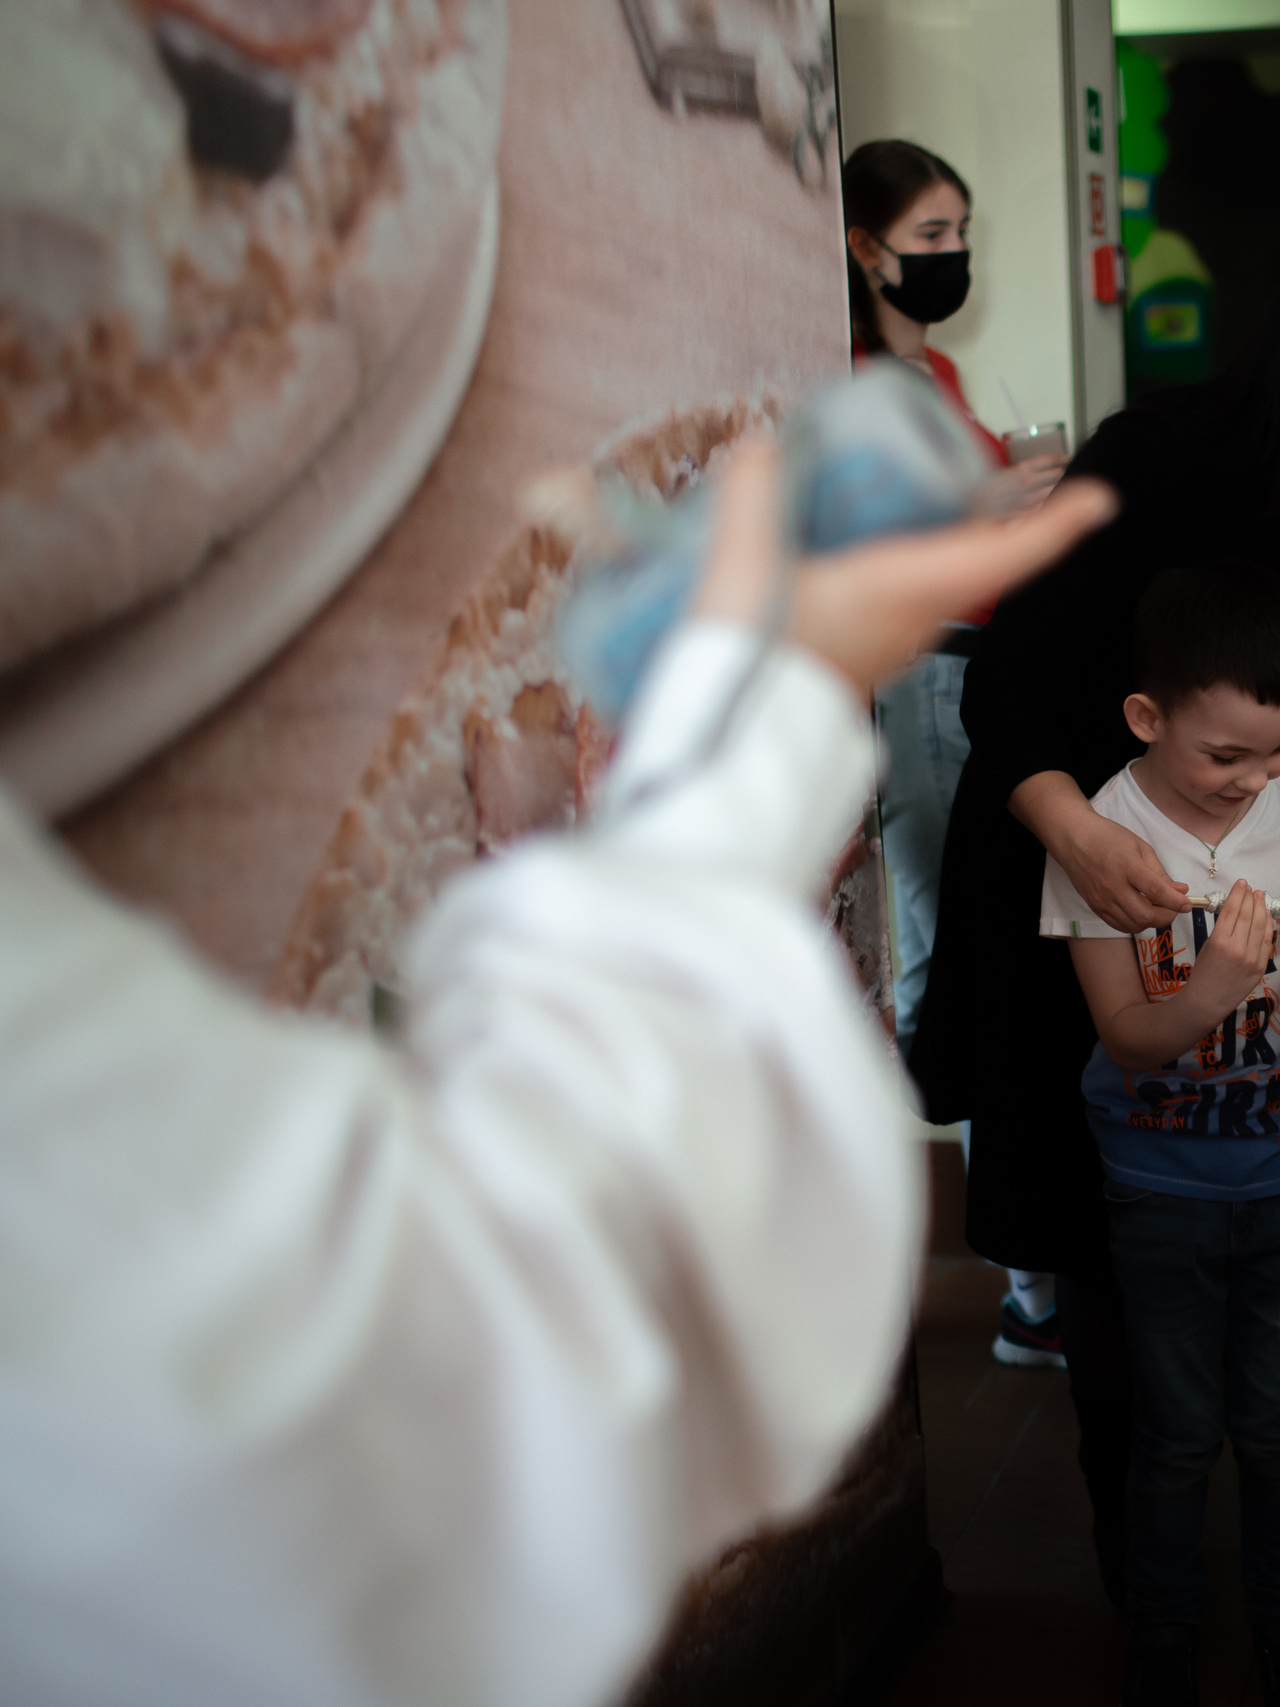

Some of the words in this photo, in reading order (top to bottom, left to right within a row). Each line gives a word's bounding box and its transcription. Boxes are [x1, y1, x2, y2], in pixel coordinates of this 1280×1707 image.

[1138, 929, 1174, 963] DEEP
[1193, 1049, 1217, 1068] TO
[1186, 1063, 1229, 1081] SURF
[1125, 1115, 1185, 1130] EVERYDAY
